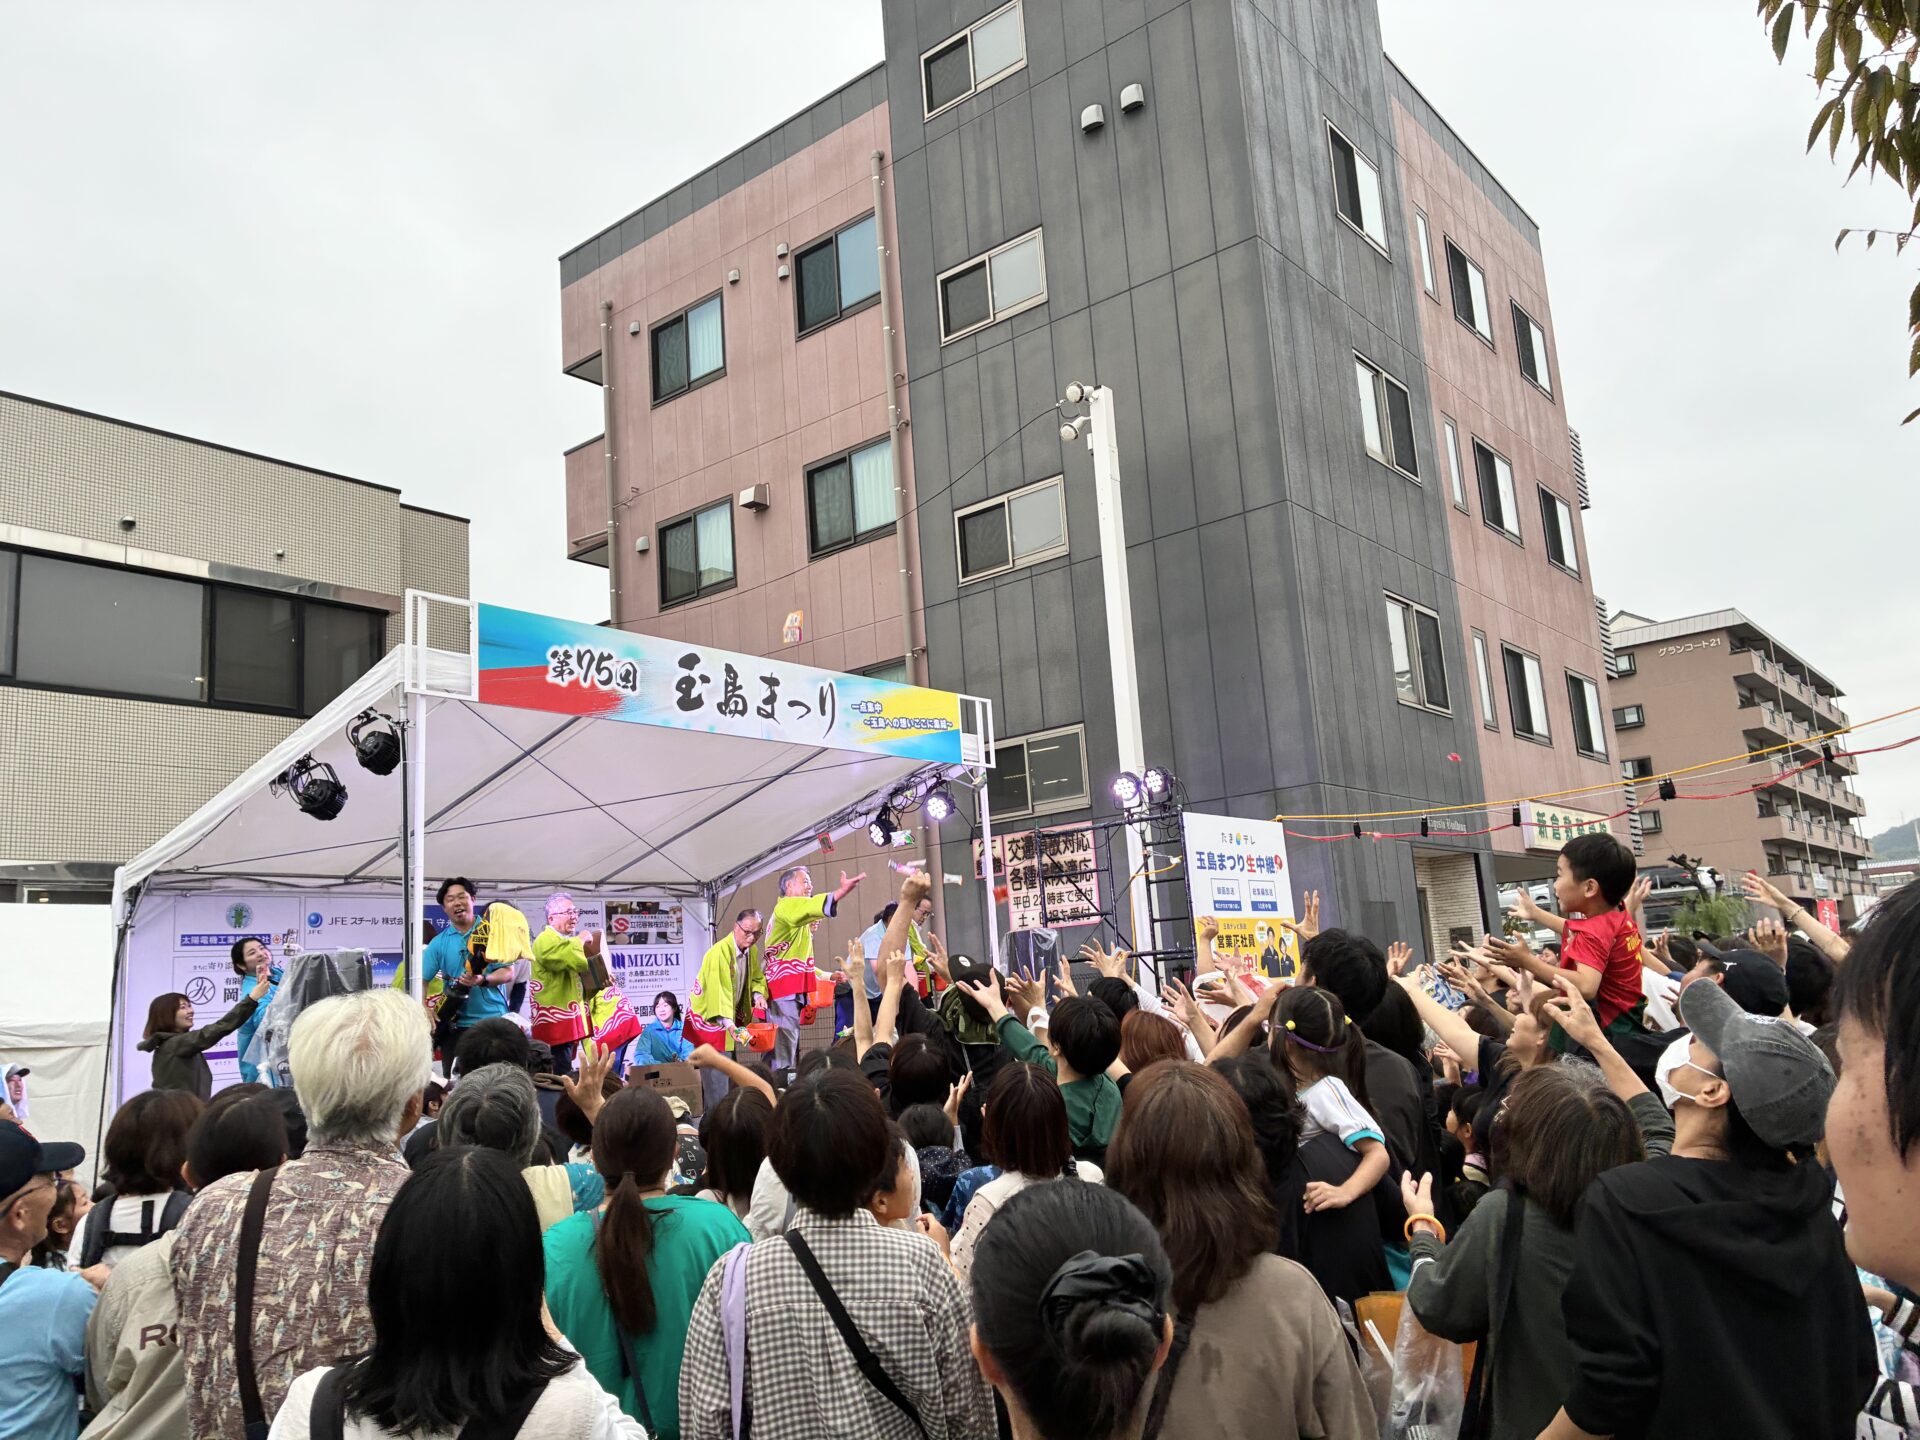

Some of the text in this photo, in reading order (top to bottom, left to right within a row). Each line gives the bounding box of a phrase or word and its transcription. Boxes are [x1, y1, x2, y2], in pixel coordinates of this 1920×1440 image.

[1658, 637, 1720, 656] グランコート21
[550, 649, 837, 739] 第75回 玉島まつり
[851, 701, 882, 714] 一点集中
[1195, 850, 1276, 874] 玉島まつり生中継
[328, 916, 404, 926] JFE スチール 株式会
[182, 934, 270, 945] 太陽電機工業社
[1217, 933, 1256, 949] 営業正社員
[627, 953, 680, 968] MIZUKI
